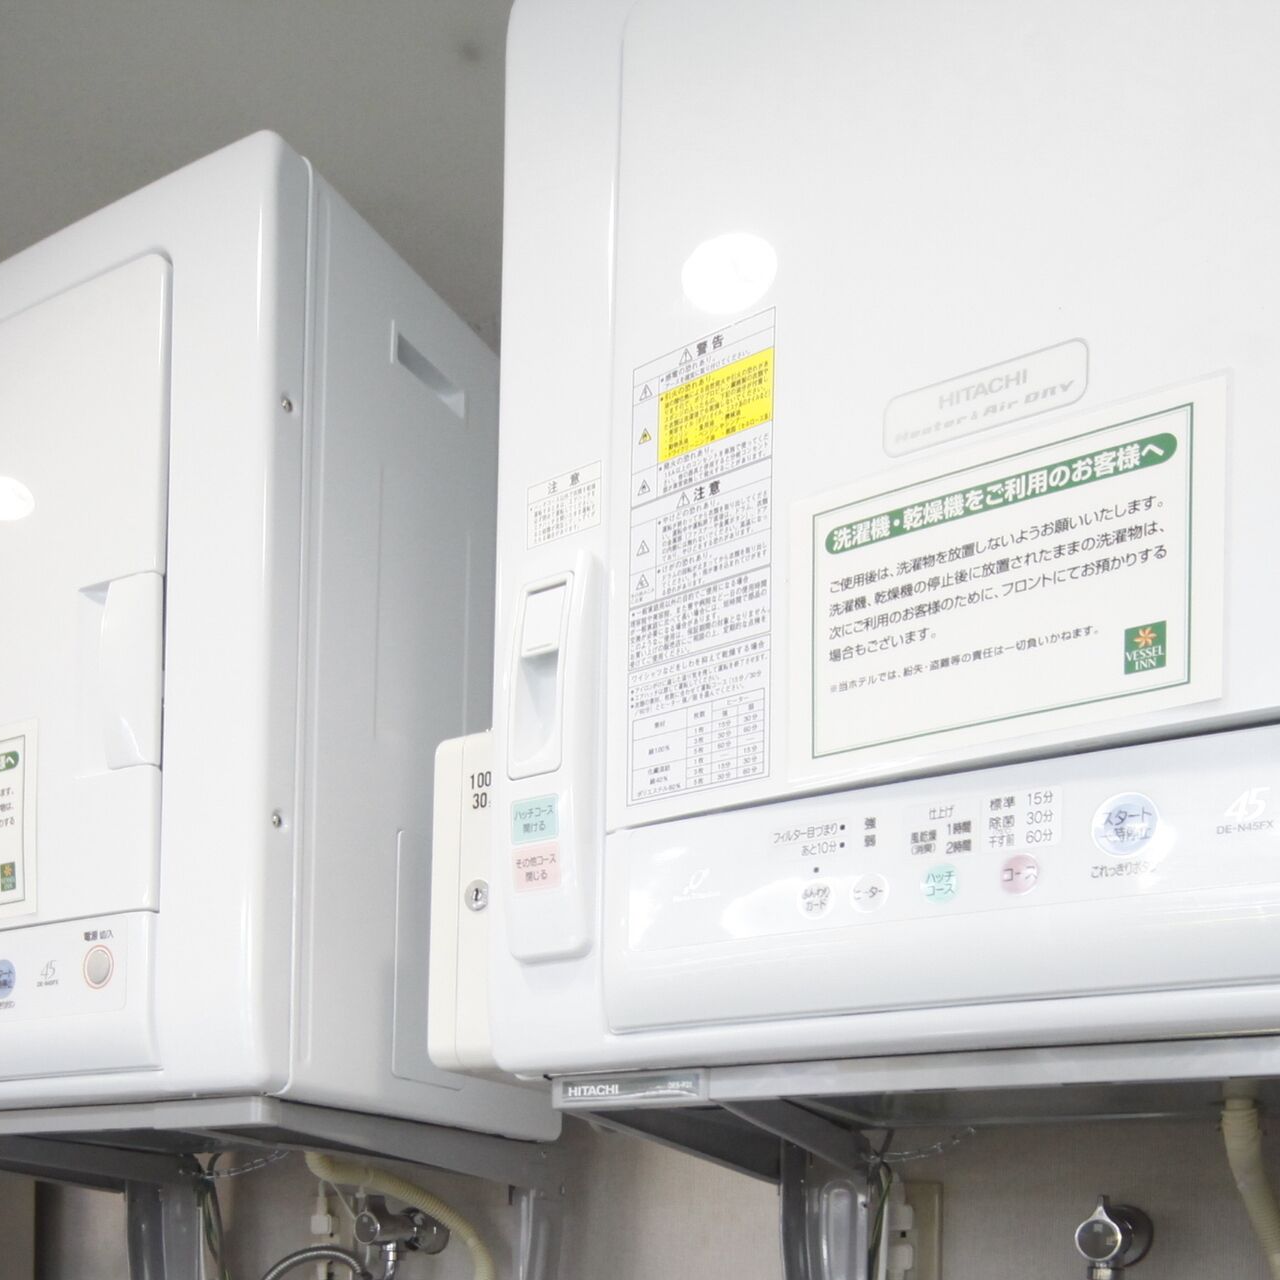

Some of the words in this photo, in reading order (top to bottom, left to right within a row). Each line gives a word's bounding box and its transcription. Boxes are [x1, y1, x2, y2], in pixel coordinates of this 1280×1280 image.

[939, 369, 1028, 410] HITACHI
[832, 442, 1165, 551] 洗濯機・乾燥機をご利用のお客様へ
[829, 496, 1166, 594] ご使用後は、洗濯物を放置しないようお願いいたします。
[829, 521, 1166, 617] 洗濯機、乾燥機の停止後に放置されたままの洗濯物は、
[829, 544, 1167, 640] 次にご利用のお客様のために、フロントにてお預かりする
[829, 629, 937, 663] 場合もございます。
[1125, 645, 1165, 662] VESSEL
[1134, 658, 1157, 670] INN
[470, 771, 492, 789] 100
[472, 791, 492, 809] 30
[989, 796, 1016, 811] 標準
[1027, 790, 1054, 806] 15分
[1224, 787, 1271, 821] 45
[1026, 810, 1054, 826] 30分
[1103, 807, 1153, 828] スタート
[1025, 828, 1054, 844] 60分
[926, 870, 954, 884] ハッチ
[1003, 865, 1038, 883] コース
[926, 882, 955, 897] コース
[568, 1084, 619, 1097] HITACHI
